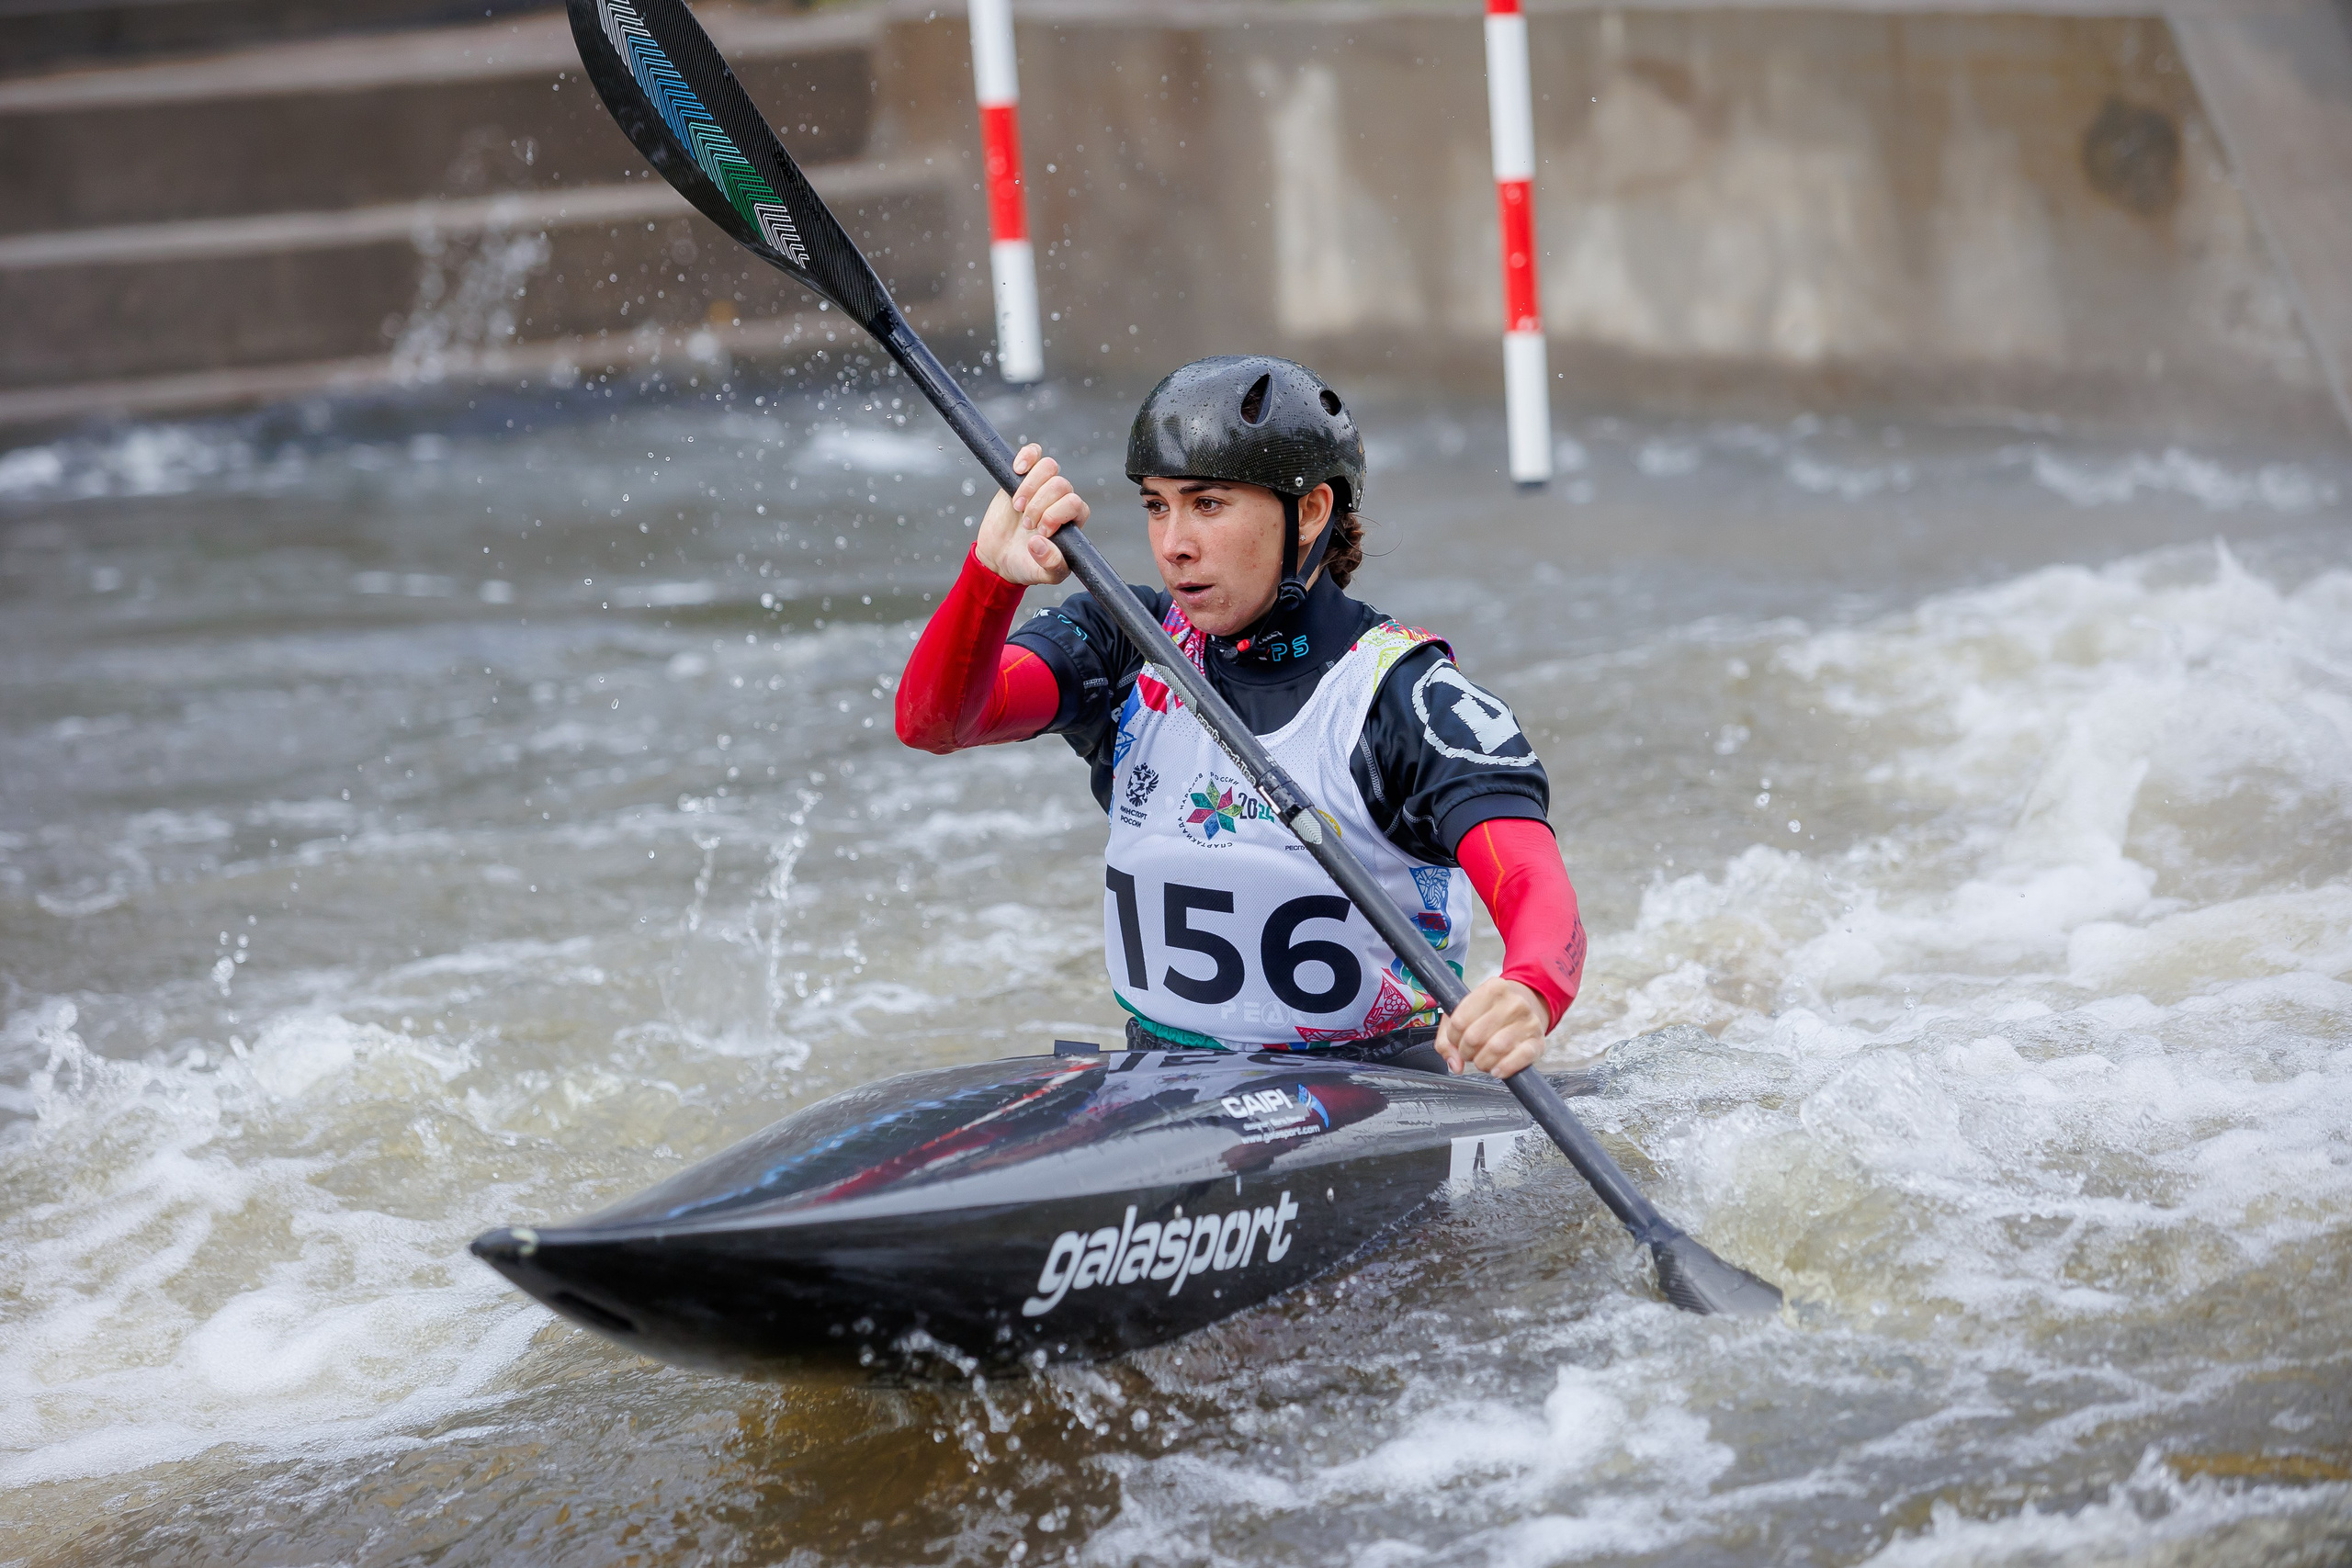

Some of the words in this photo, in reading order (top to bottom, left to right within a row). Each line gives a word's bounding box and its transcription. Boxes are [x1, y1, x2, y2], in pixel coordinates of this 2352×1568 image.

[1210, 771, 1239, 786] РОССИИ
[1106, 863, 1362, 1014] 156
[1220, 1088, 1295, 1119] CAIPI
[1241, 1123, 1321, 1145] www.galasport.com
[1021, 1190, 1299, 1317] galasport
